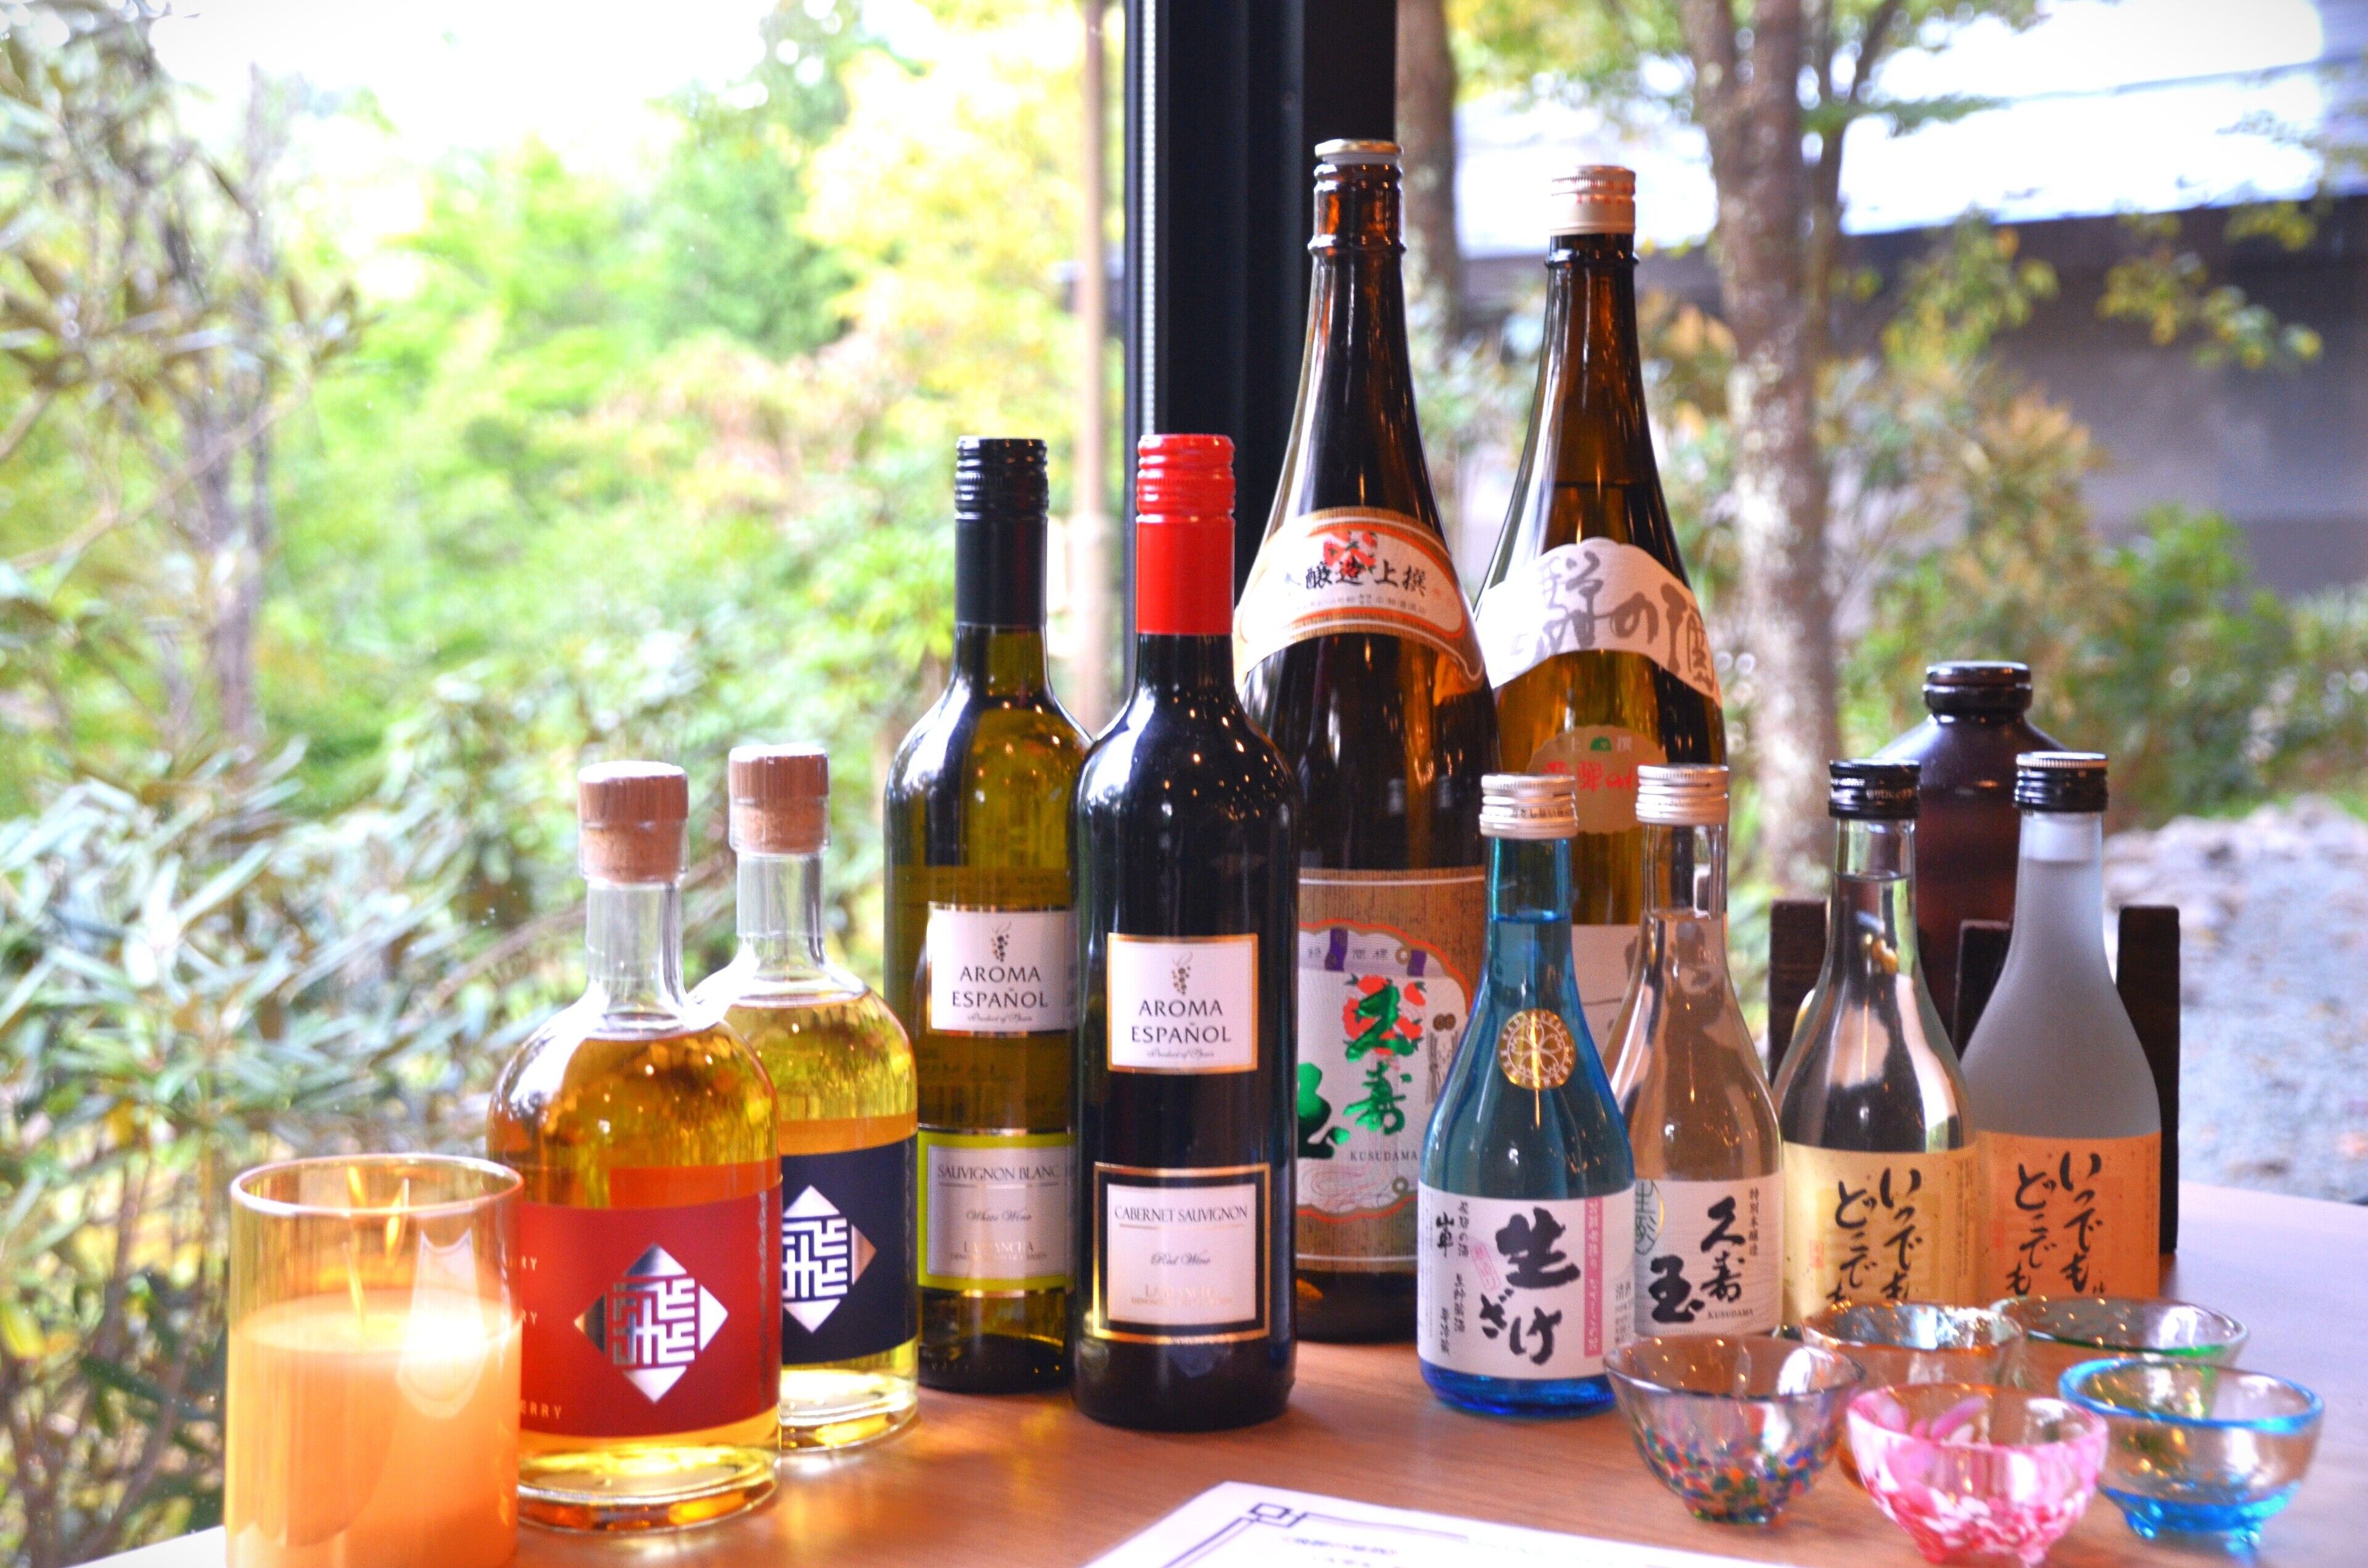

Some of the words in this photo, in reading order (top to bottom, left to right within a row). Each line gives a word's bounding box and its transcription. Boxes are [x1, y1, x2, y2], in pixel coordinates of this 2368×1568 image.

[960, 966, 1040, 982] AROMA
[952, 987, 1048, 1008] ESPAÑOL
[1139, 999, 1223, 1017] AROMA
[1132, 1022, 1232, 1043] ESPAÑOL
[1350, 1149, 1418, 1163] KUSUDAMA
[938, 1164, 1014, 1181] SAUVIGNON
[1019, 1164, 1060, 1179] BLANC
[1115, 1205, 1175, 1223] CABERNET
[1177, 1205, 1248, 1223] SAUVIGNON
[2059, 1151, 2104, 1293] いつでも
[2005, 1163, 2057, 1295] どこでも
